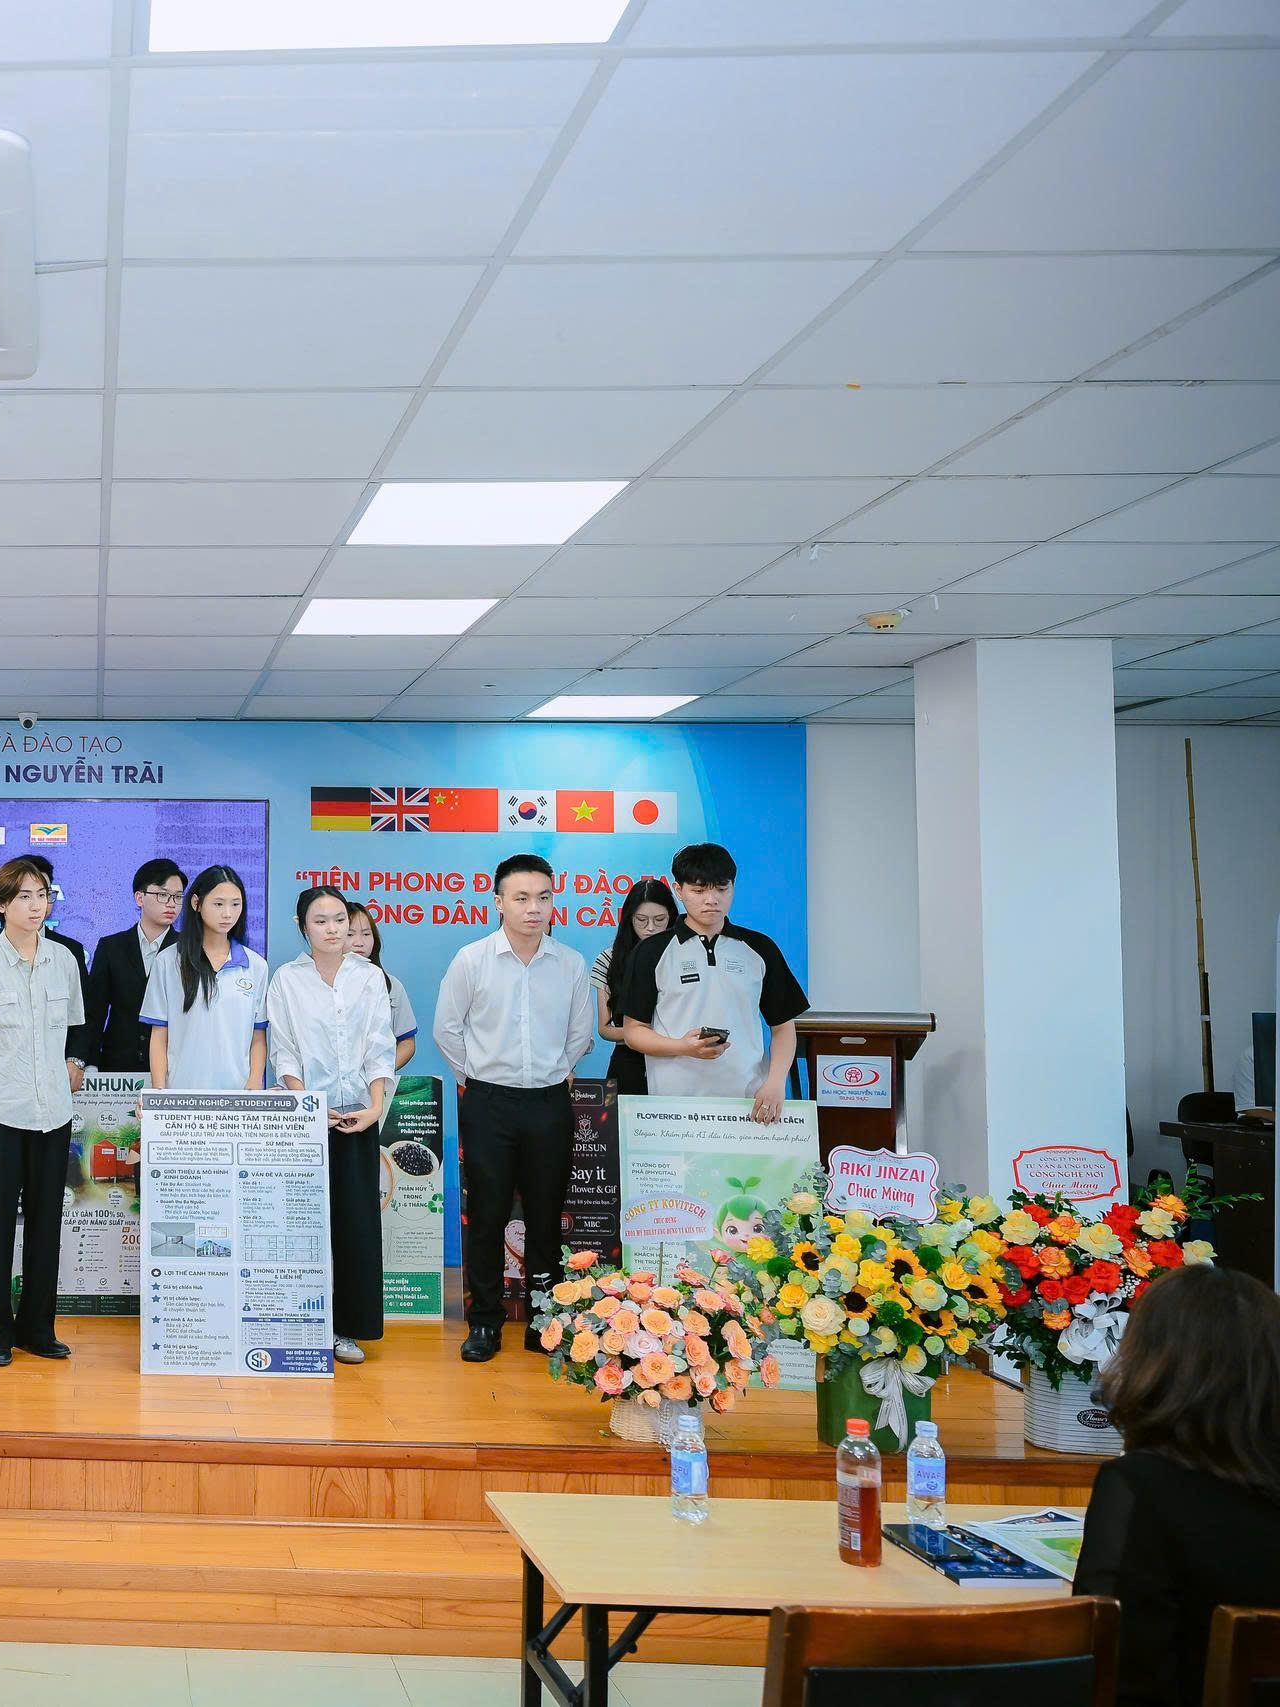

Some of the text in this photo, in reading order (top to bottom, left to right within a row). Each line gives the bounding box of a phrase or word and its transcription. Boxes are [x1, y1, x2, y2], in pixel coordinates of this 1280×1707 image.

[22, 732, 73, 753] ĐÀO
[79, 736, 123, 757] TẠO
[4, 756, 104, 784] NGUYỄN
[111, 761, 164, 784] TRÃI
[369, 871, 465, 892] PHONG
[573, 868, 635, 894] ĐÀO
[369, 899, 488, 925] ÔNG DÂN
[576, 897, 623, 927] CẦ
[636, 1112, 682, 1120] FLOWERKID
[739, 1113, 752, 1122] MẦ
[596, 1166, 606, 1180] it
[840, 1162, 925, 1182] RIKI JINZAI
[848, 1182, 914, 1208] Chúc Mừng
